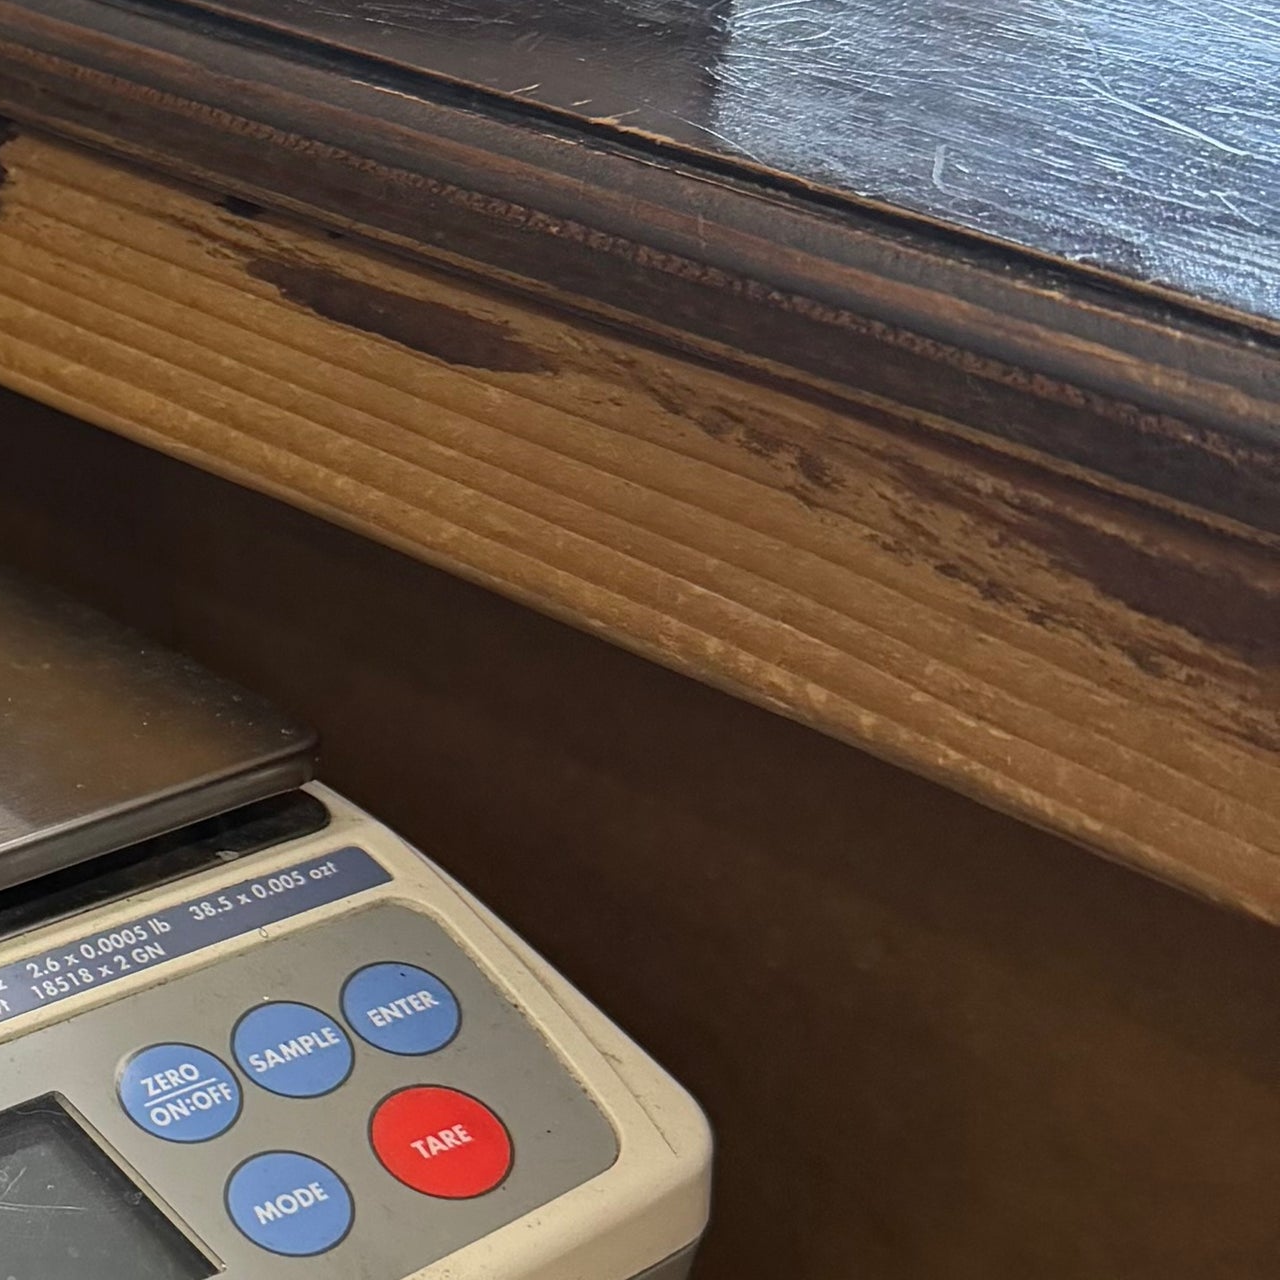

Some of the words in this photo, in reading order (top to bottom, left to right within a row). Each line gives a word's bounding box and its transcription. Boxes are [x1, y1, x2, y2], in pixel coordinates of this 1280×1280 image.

[26, 957, 60, 979] 2.6
[64, 952, 79, 967] x
[79, 925, 148, 960] 0.0005
[150, 918, 171, 935] lb
[189, 894, 234, 921] 38.5
[235, 891, 252, 906] x
[251, 871, 306, 900] 0.005
[308, 861, 339, 880] ozt
[30, 967, 95, 1001] 18518
[98, 963, 114, 978] x
[116, 954, 131, 971] 2
[131, 942, 166, 964] GN
[366, 989, 440, 1028] ENTER
[248, 1025, 340, 1074] SAMPLE
[140, 1063, 200, 1098] ZERO
[149, 1081, 234, 1128] ON:OFF
[410, 1123, 474, 1160] TARE
[253, 1181, 330, 1226] MODE
